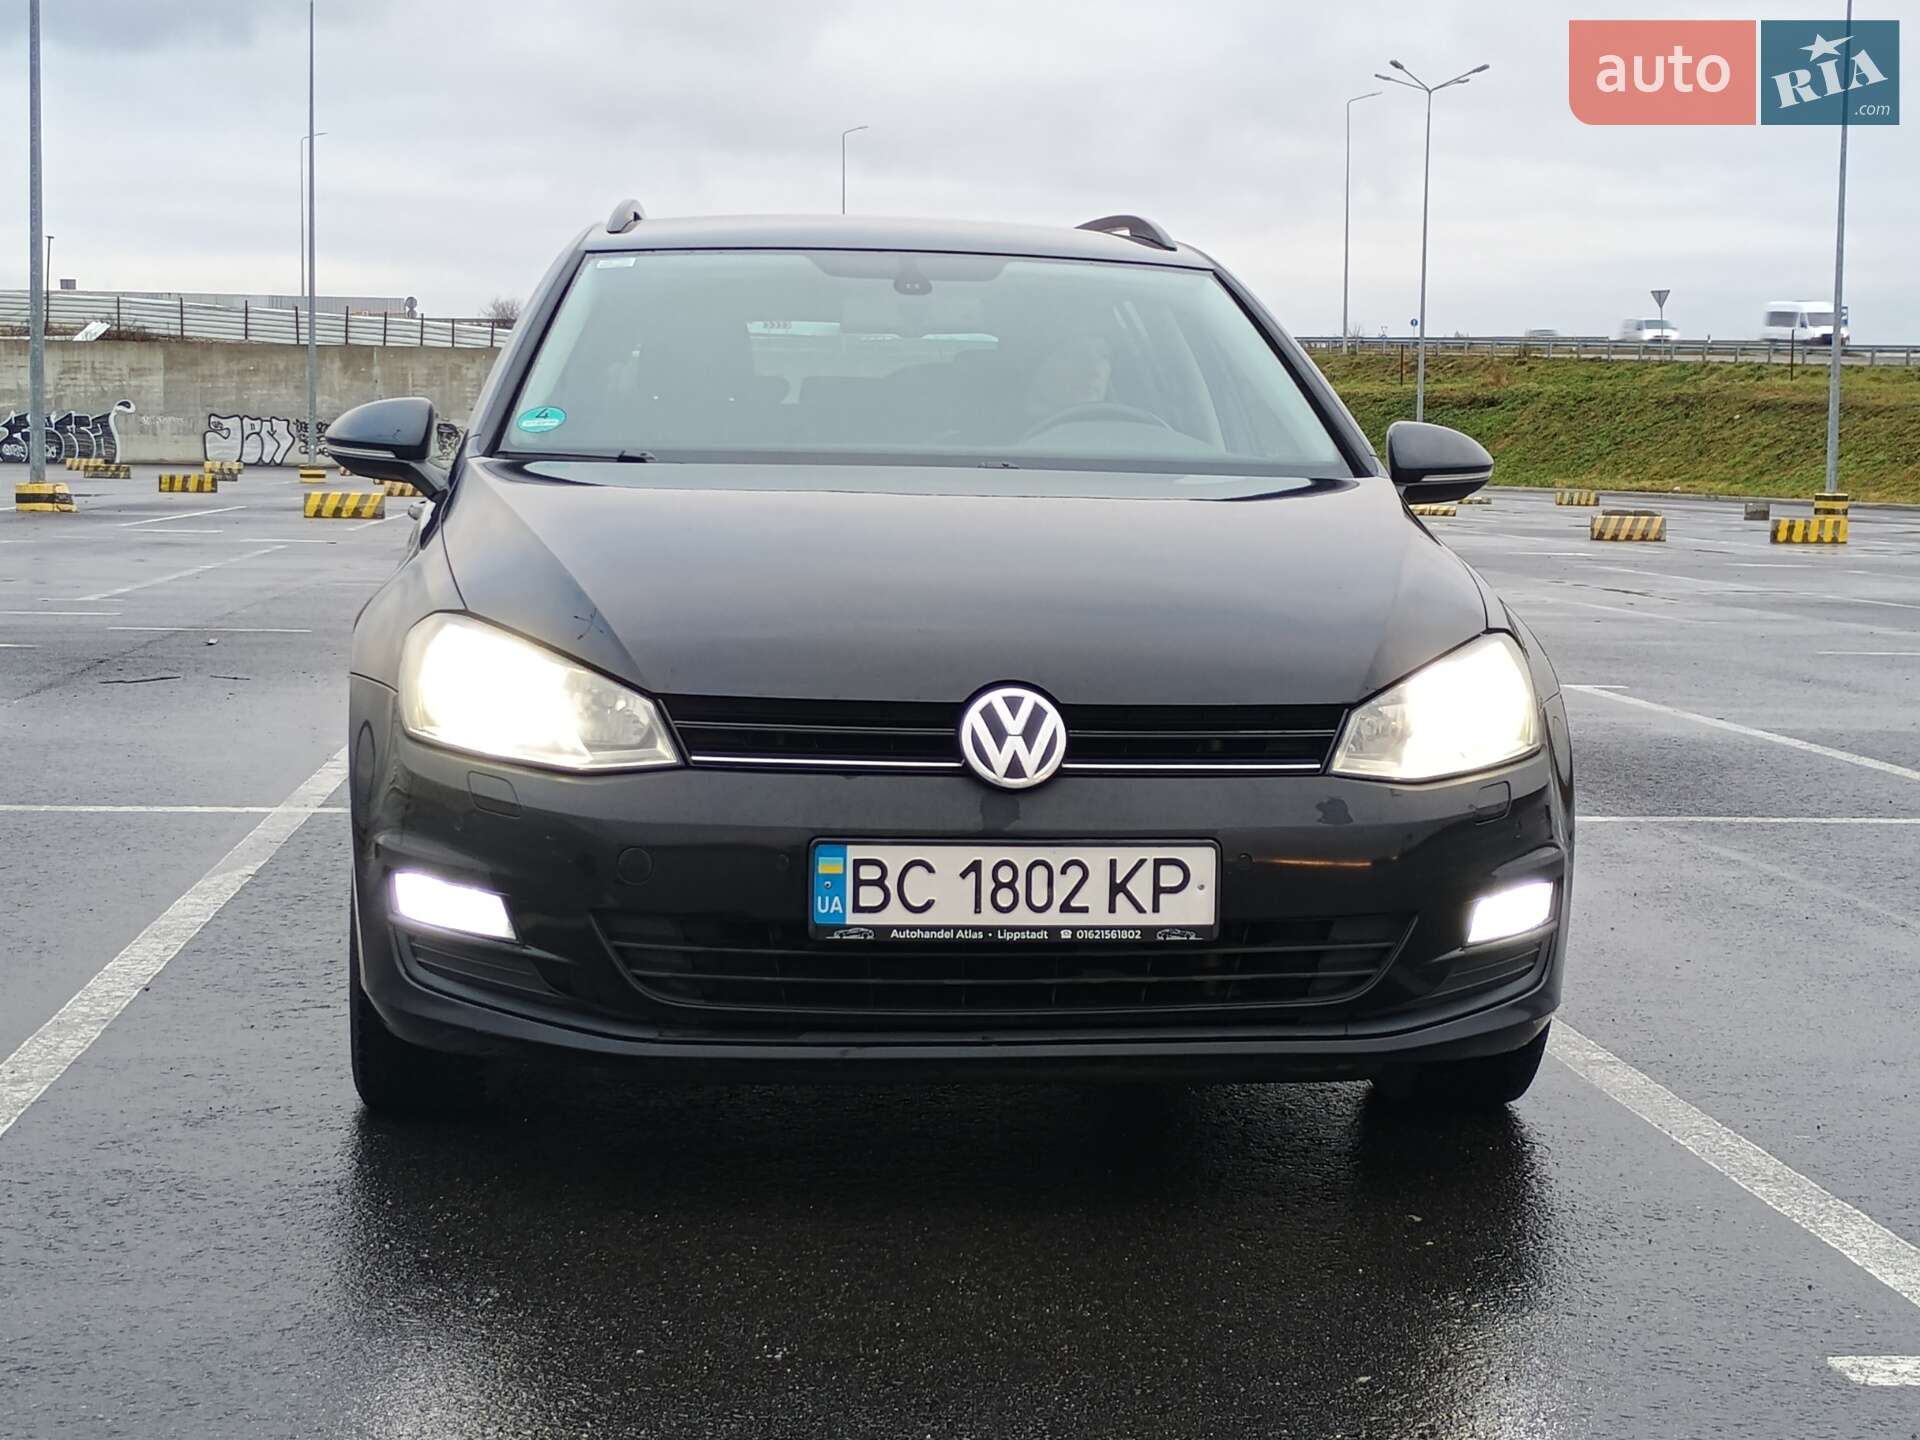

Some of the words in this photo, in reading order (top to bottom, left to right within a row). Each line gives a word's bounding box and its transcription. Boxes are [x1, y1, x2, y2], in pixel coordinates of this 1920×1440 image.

[852, 857, 936, 914] BC
[959, 858, 1090, 914] 1802
[1107, 857, 1192, 914] KP
[817, 895, 844, 913] UA
[890, 929, 954, 939] Autohandel
[956, 929, 983, 939] Atlas
[997, 929, 1049, 941] Lippstadt
